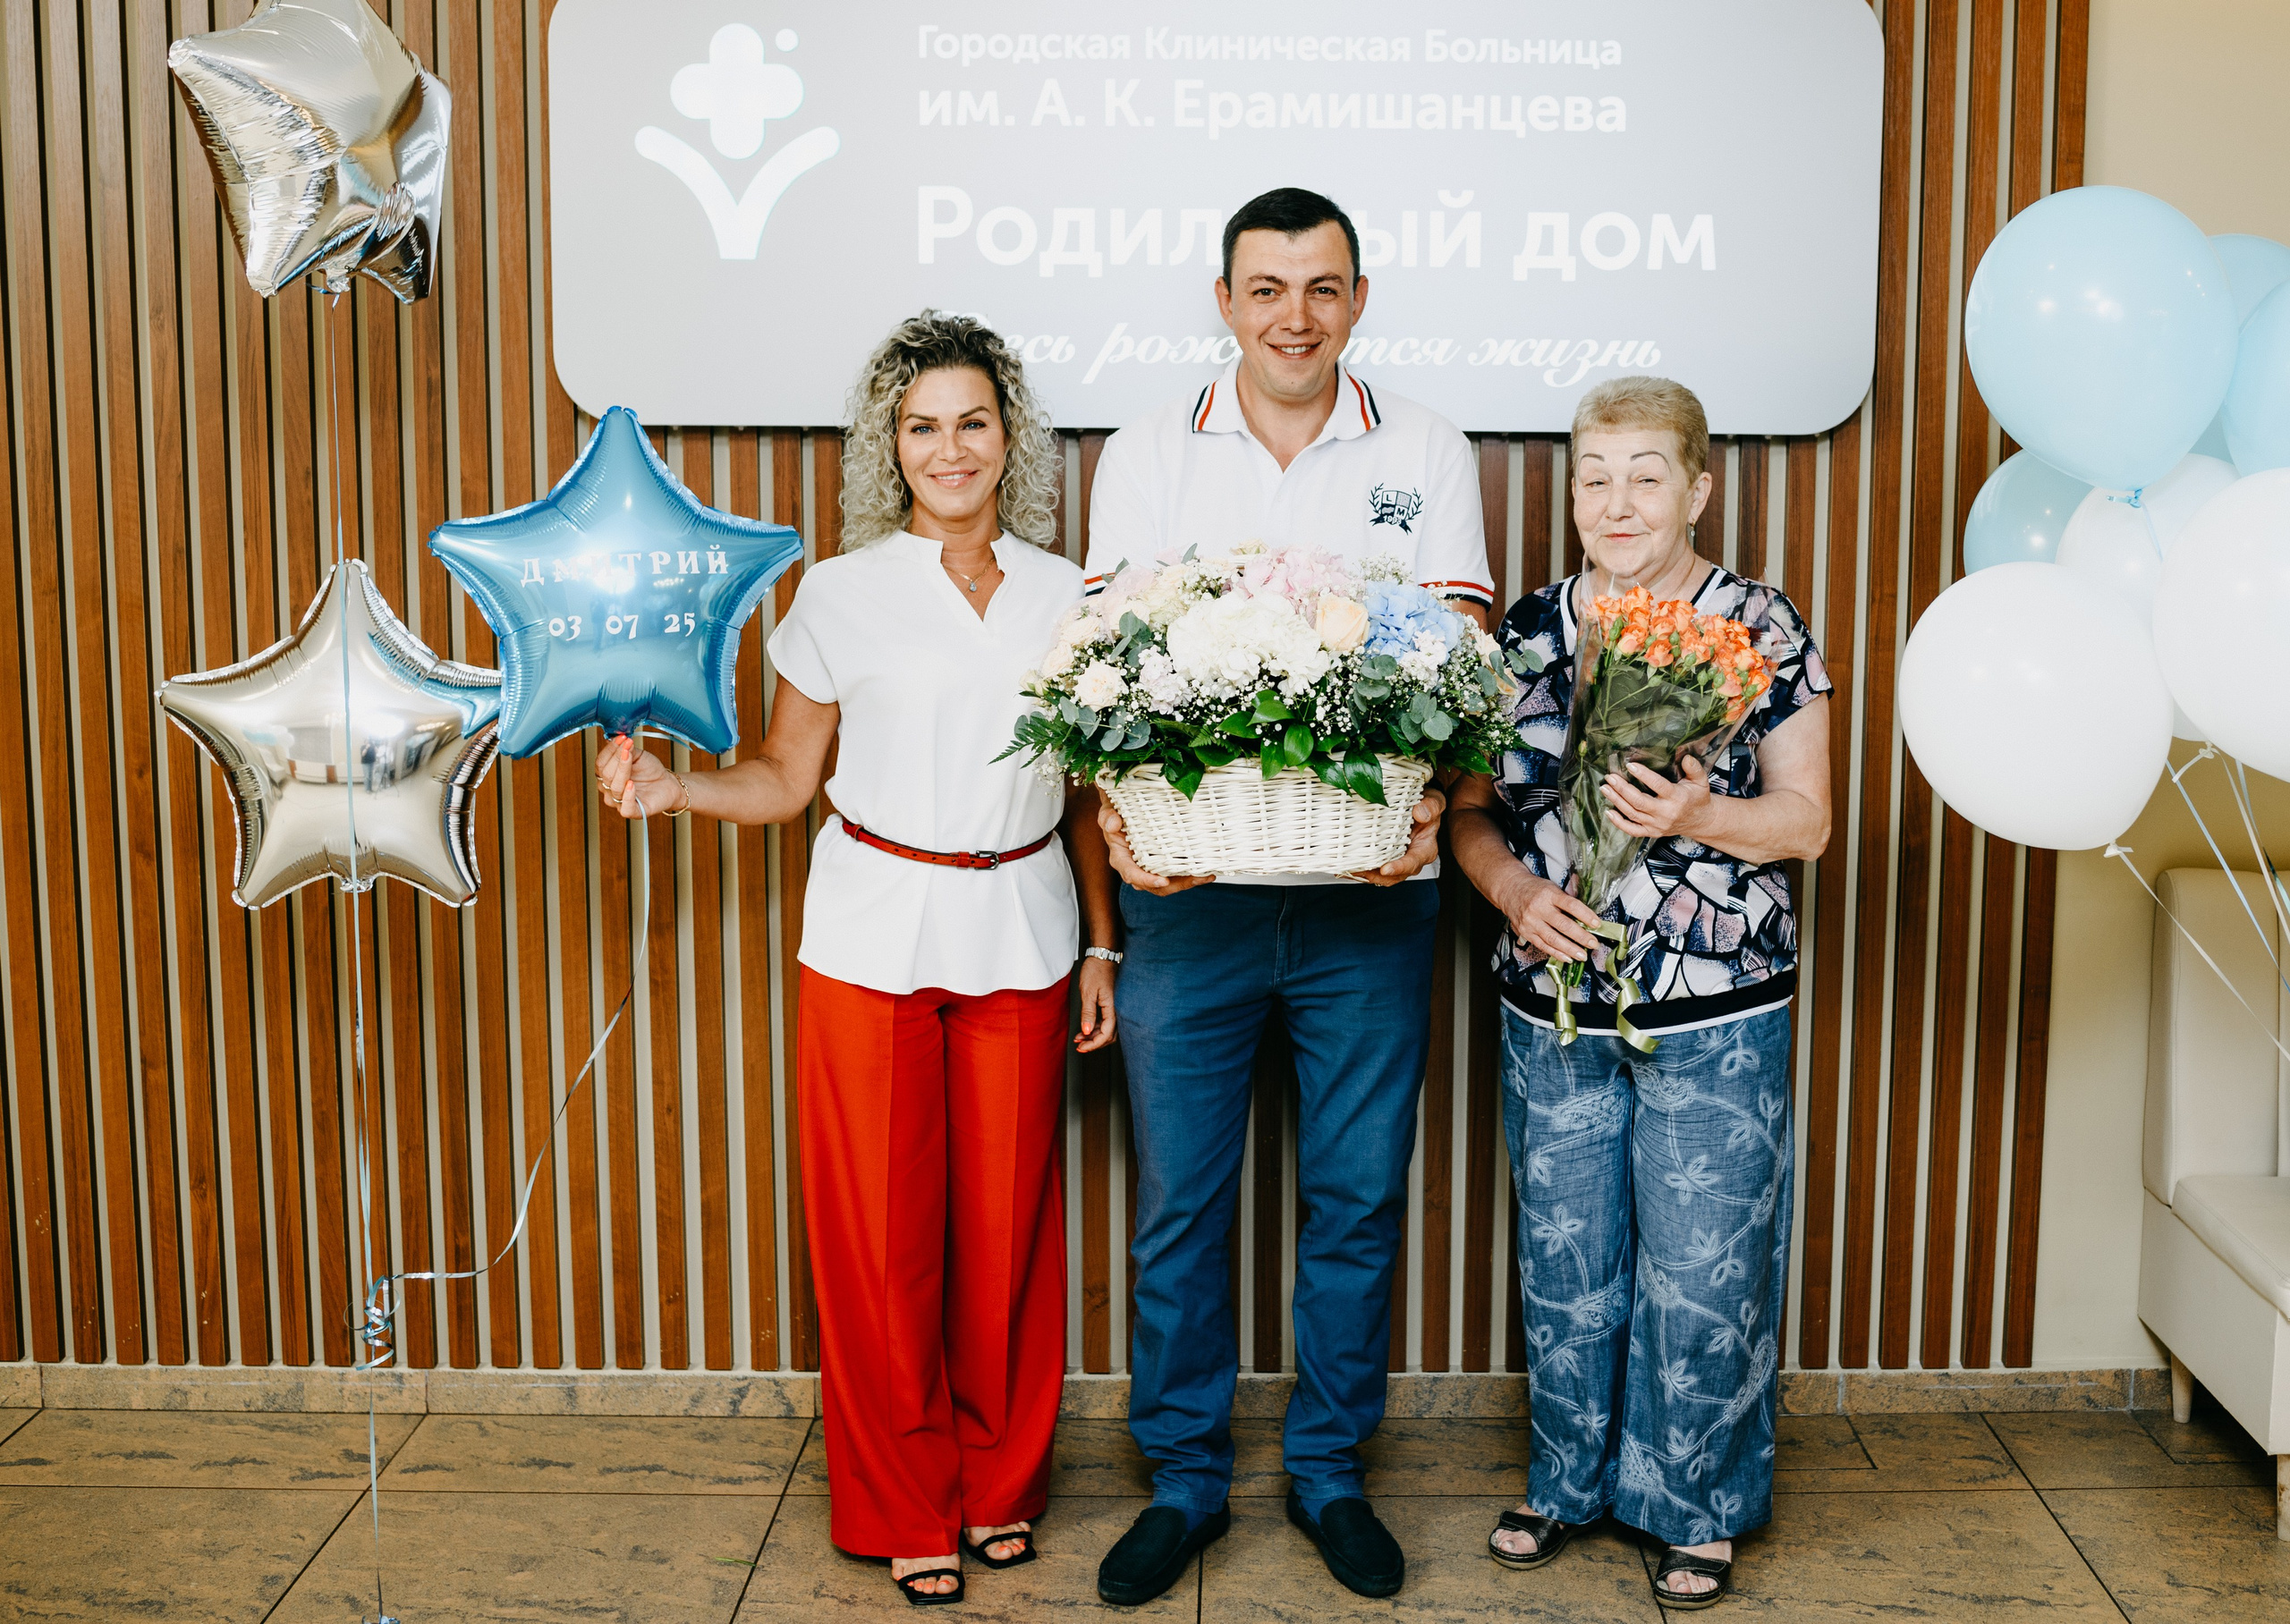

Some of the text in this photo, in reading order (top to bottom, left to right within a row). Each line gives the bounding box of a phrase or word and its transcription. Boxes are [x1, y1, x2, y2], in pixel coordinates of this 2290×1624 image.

[918, 24, 1623, 70] Городская Клиническая Больница
[918, 78, 1627, 140] им. А. К. Ерамишанцева
[917, 184, 1718, 283] Родилый дом
[932, 310, 1662, 388] есь рожтся жизнь
[1396, 507, 1405, 517] M
[520, 544, 729, 588] ДМИТРИЙ
[548, 612, 696, 641] 03 07 25
